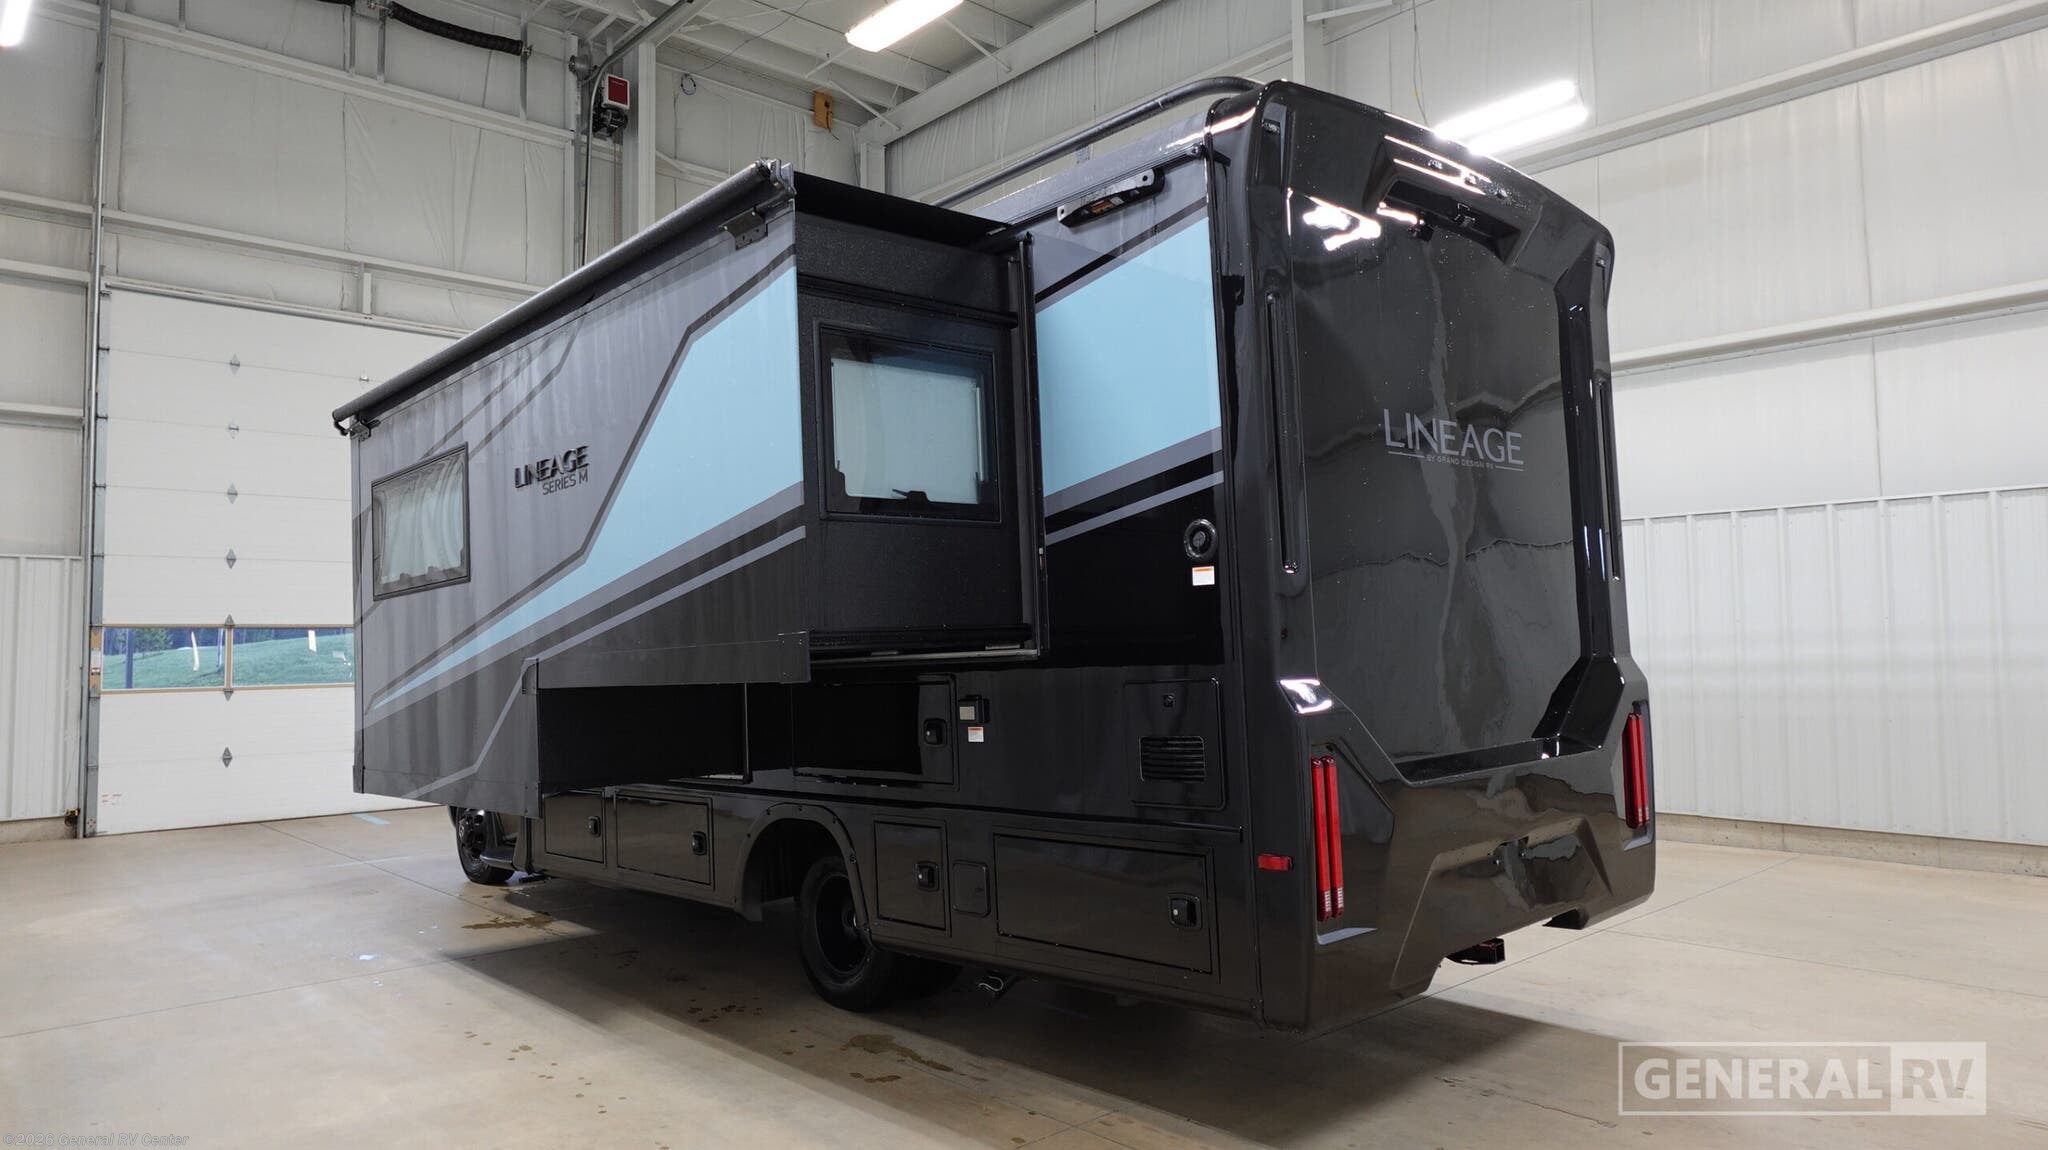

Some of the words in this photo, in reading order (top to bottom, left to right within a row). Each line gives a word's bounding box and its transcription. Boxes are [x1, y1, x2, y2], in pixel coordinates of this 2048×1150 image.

[1383, 408, 1525, 466] LINEAGE
[514, 445, 590, 489] LINEAGE
[1437, 455, 1460, 466] GRAND
[1461, 458, 1485, 469] DESIGN
[542, 473, 577, 496] SERIES
[579, 468, 589, 484] M
